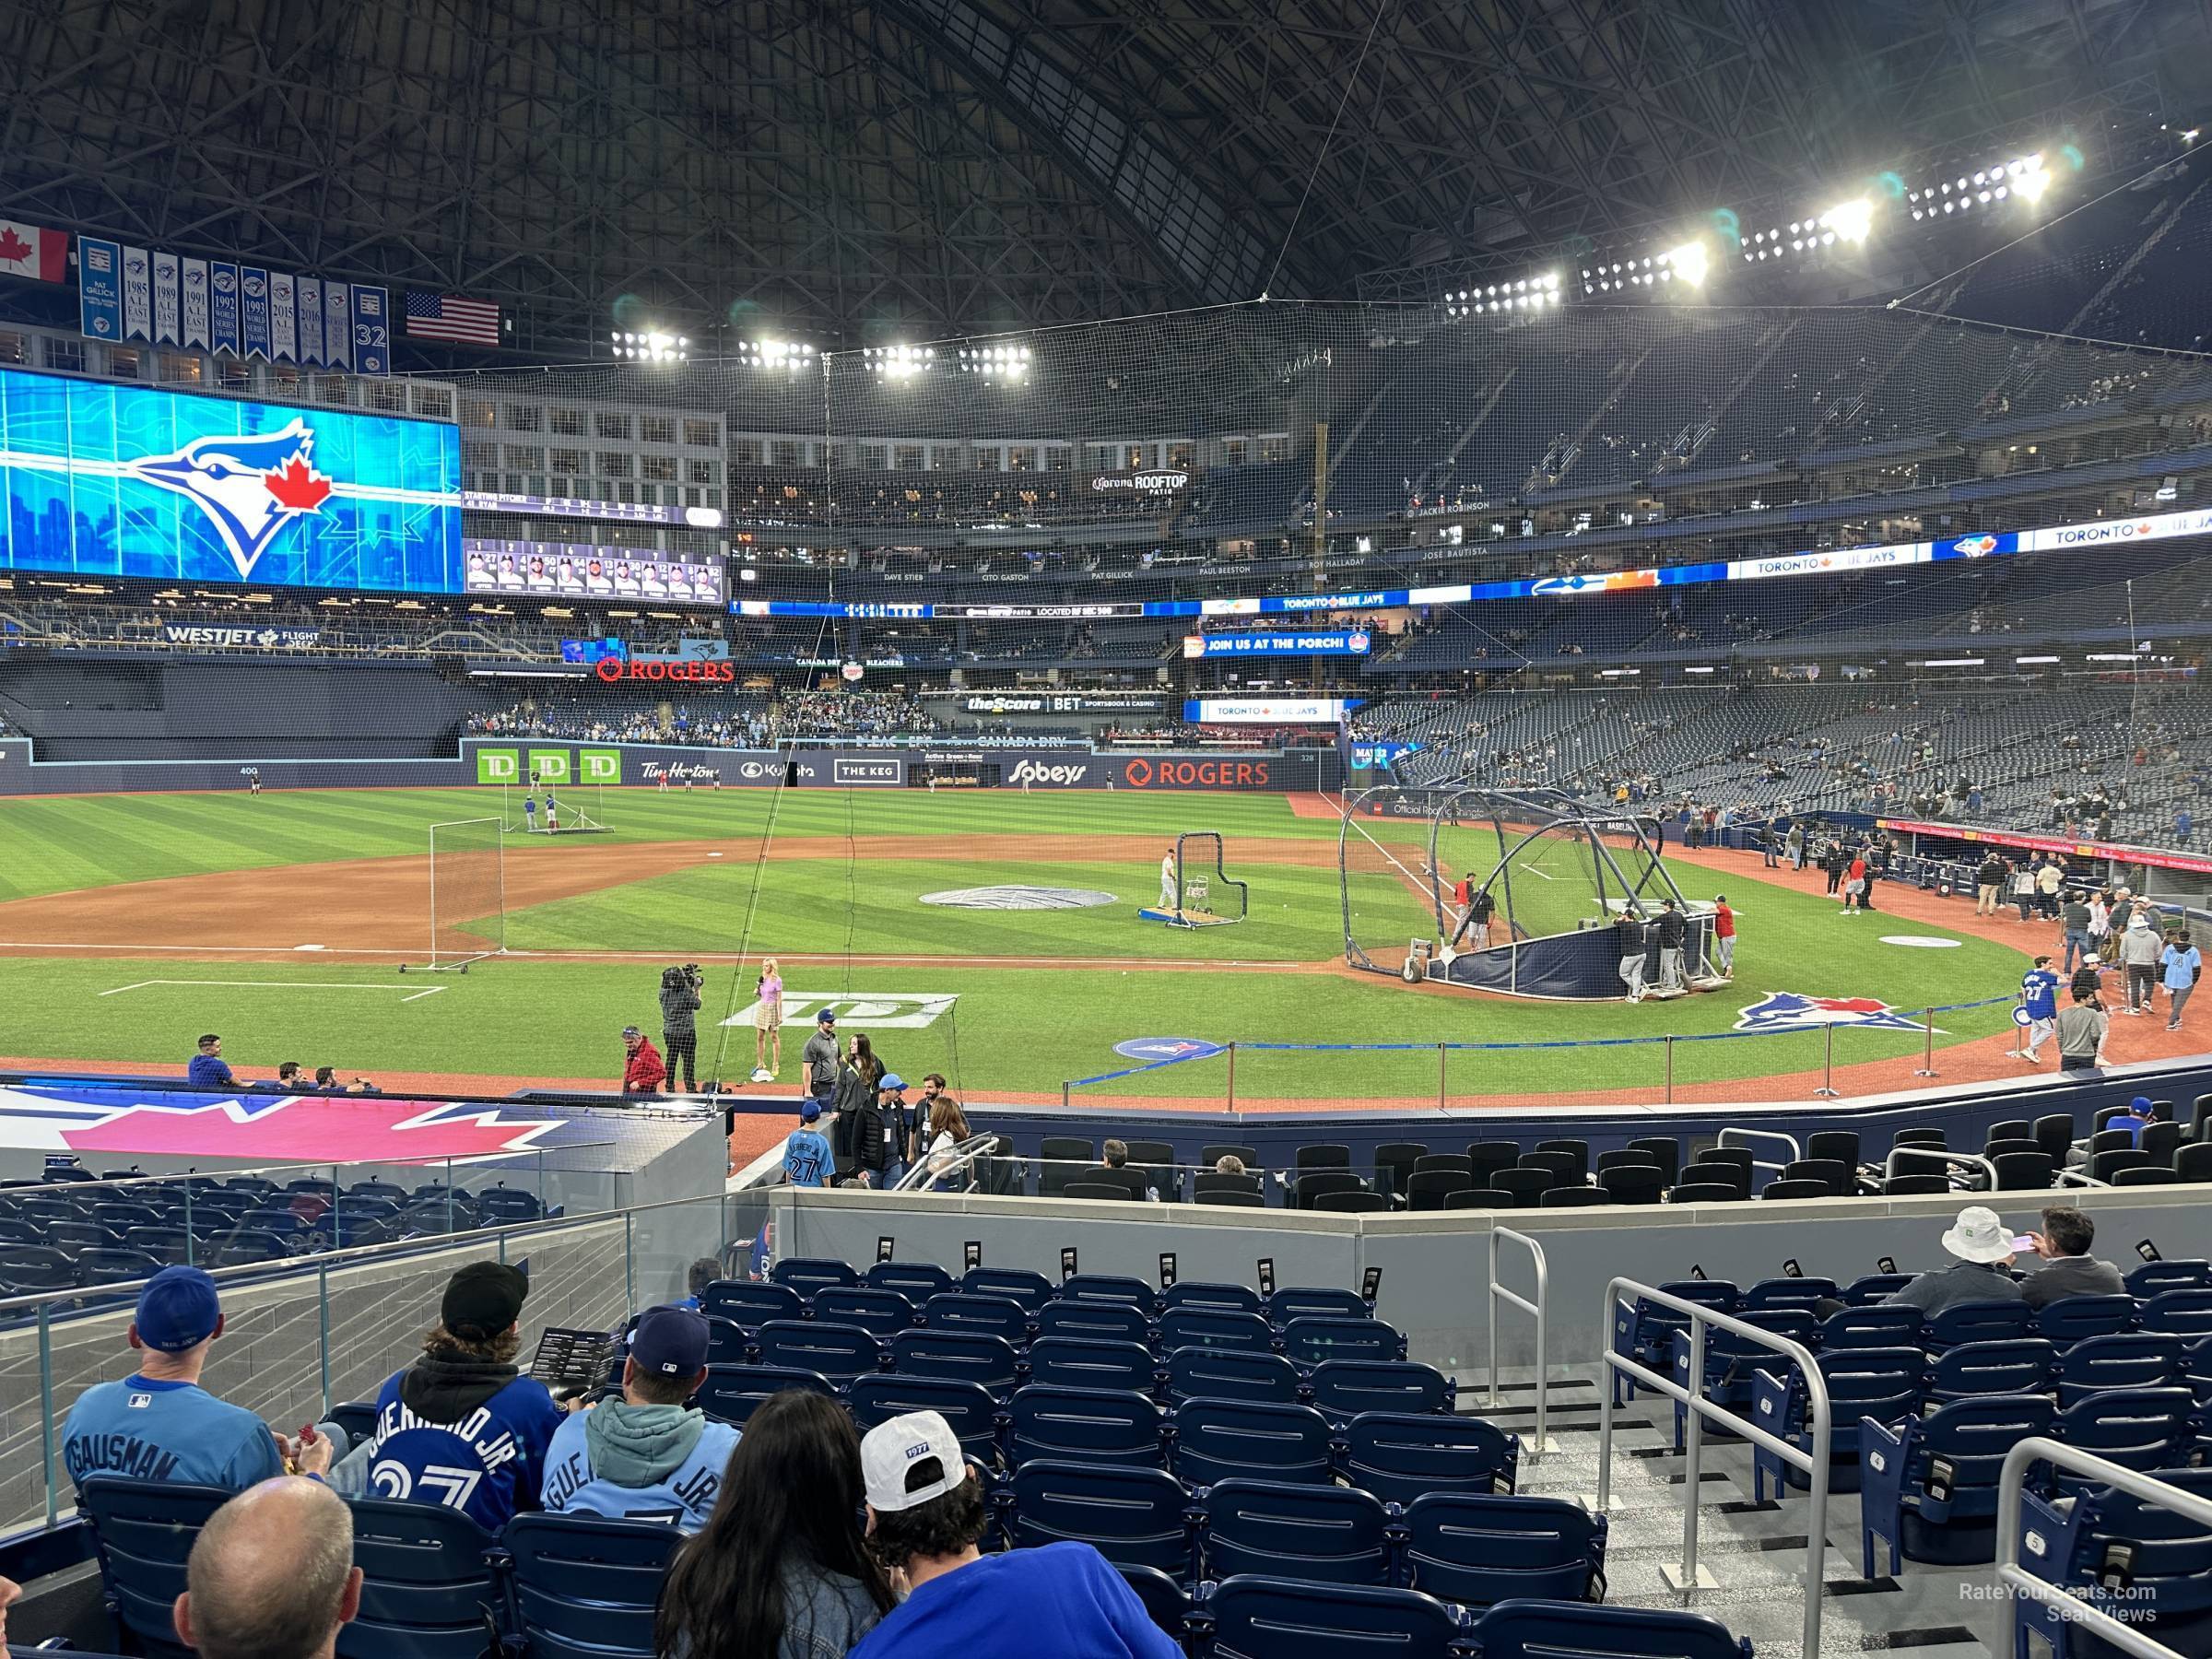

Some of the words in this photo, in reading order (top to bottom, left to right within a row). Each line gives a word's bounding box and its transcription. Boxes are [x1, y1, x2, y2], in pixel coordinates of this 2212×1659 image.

[127, 280, 147, 295] 1985
[157, 286, 176, 300] 1989
[186, 291, 206, 305] 1991
[215, 295, 235, 310] 1992
[245, 300, 265, 315] 1993
[273, 304, 293, 319] 2015
[128, 309, 147, 318] EAST
[158, 313, 176, 323] EAST
[216, 310, 235, 319] WORLD
[246, 314, 265, 324] WORLD
[301, 309, 321, 323] 2016
[186, 317, 206, 326] EAST
[216, 320, 235, 330] SERIES
[216, 329, 236, 338] CHAMPS
[247, 324, 266, 333] SERIES
[247, 335, 266, 343] CHAMPS
[356, 324, 387, 347] 32
[1092, 477, 1133, 491] Corona
[1135, 476, 1187, 488] ROOFTOP
[464, 491, 498, 501] STARTING
[479, 500, 498, 509] RYAN
[1418, 507, 1445, 516] JACKIE
[1448, 501, 1489, 513] ROBINSON
[2056, 524, 2134, 544] TORONTO
[477, 542, 481, 550] 1
[509, 544, 513, 552] 2
[537, 545, 543, 554] 3
[485, 554, 496, 562] 27
[653, 553, 658, 561] 7
[1448, 547, 1488, 559] BAUTISTA
[520, 556, 526, 565] 4
[544, 557, 556, 566] 50
[573, 559, 586, 567] 64
[605, 560, 614, 569] 13
[1309, 560, 1324, 569] ROY
[1326, 559, 1365, 568] HALLADAY
[1758, 559, 1818, 573] TORONTO
[1865, 550, 1896, 564] JAYS
[629, 562, 641, 571] 30
[659, 564, 667, 572] 12
[1218, 566, 1251, 574] BEESTON
[1106, 571, 1133, 579] GILLICK
[1283, 598, 1328, 608] TORONTO
[1338, 596, 1360, 606] BLUE
[1362, 594, 1384, 605] JAYS
[166, 627, 256, 645] WESTJET
[282, 631, 319, 641] FLIGHT
[1208, 641, 1232, 651] JOIN
[1236, 640, 1251, 650] US
[1253, 640, 1268, 649] AT
[1272, 639, 1294, 649] THE
[1298, 638, 1344, 649] PORCH!
[630, 660, 735, 682] ROGERS
[968, 697, 1041, 711] theScore
[1054, 698, 1081, 711] BET
[978, 736, 1035, 747] CANADA
[481, 756, 515, 776] TD
[533, 756, 566, 777] TD
[584, 756, 617, 776] TD
[765, 764, 815, 777] Kuta
[842, 767, 867, 775] THE
[869, 767, 893, 776] KEG
[1008, 759, 1087, 784] Sobeys
[1159, 762, 1269, 784] ROGERS
[1394, 805, 1421, 815] Official
[2173, 956, 2183, 968] 4
[2025, 986, 2041, 1000] 27
[790, 1157, 818, 1182] 27
[1763, 1402, 1769, 1410] 3
[369, 1400, 491, 1458] GUERO
[475, 1430, 516, 1476] JR.
[906, 1443, 929, 1457] 1977
[71, 1433, 182, 1480] GAUSMAN
[1874, 1457, 1880, 1465] 4
[371, 1459, 483, 1511] 27
[2031, 1538, 2039, 1549] 5
